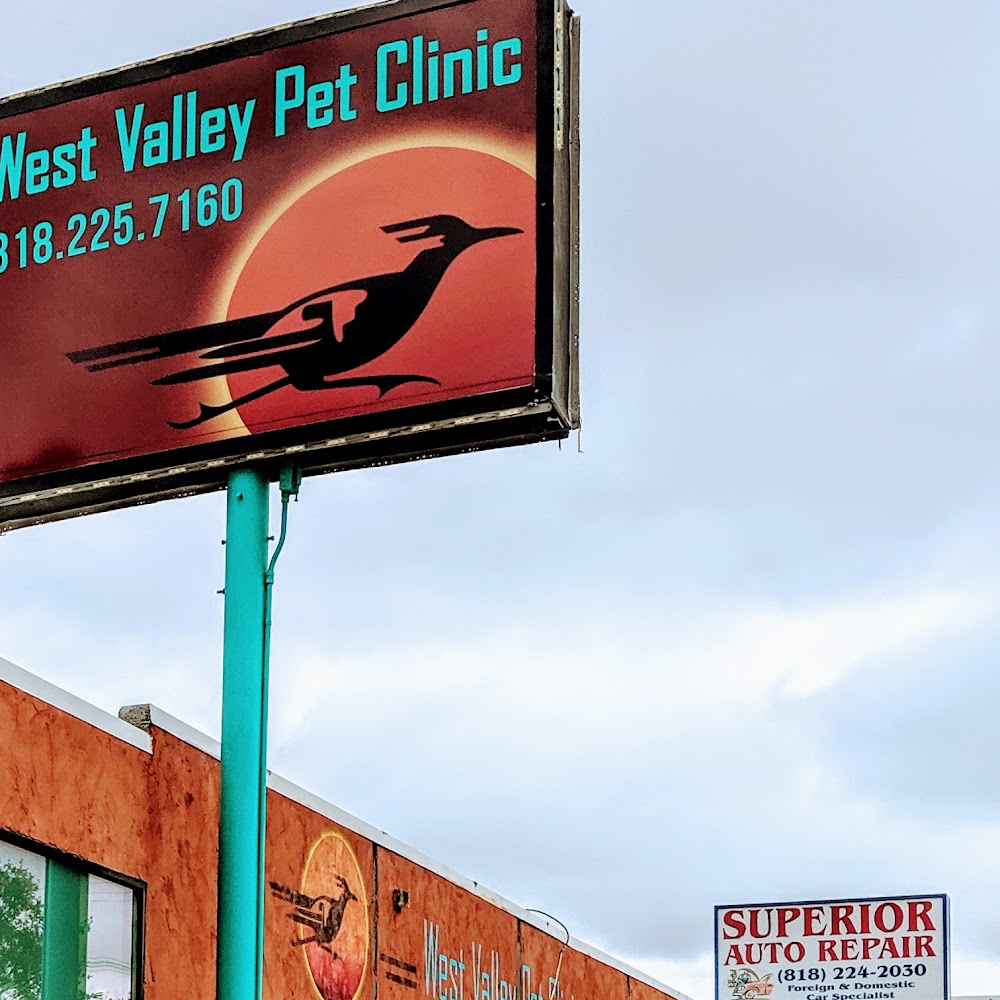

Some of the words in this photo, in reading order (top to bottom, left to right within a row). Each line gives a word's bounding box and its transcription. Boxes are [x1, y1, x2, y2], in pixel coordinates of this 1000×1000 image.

[115, 90, 256, 172] Valley
[275, 64, 358, 137] Pet
[376, 29, 522, 112] Clinic
[722, 900, 936, 940] SUPERIOR
[723, 941, 806, 966] AUTO
[818, 935, 937, 962] REPAIR
[777, 967, 826, 984] (818)
[833, 963, 927, 980] 224-2030
[787, 983, 835, 993] Foreign
[839, 983, 851, 991] &
[854, 980, 916, 990] Domestic
[806, 993, 829, 1000] Car
